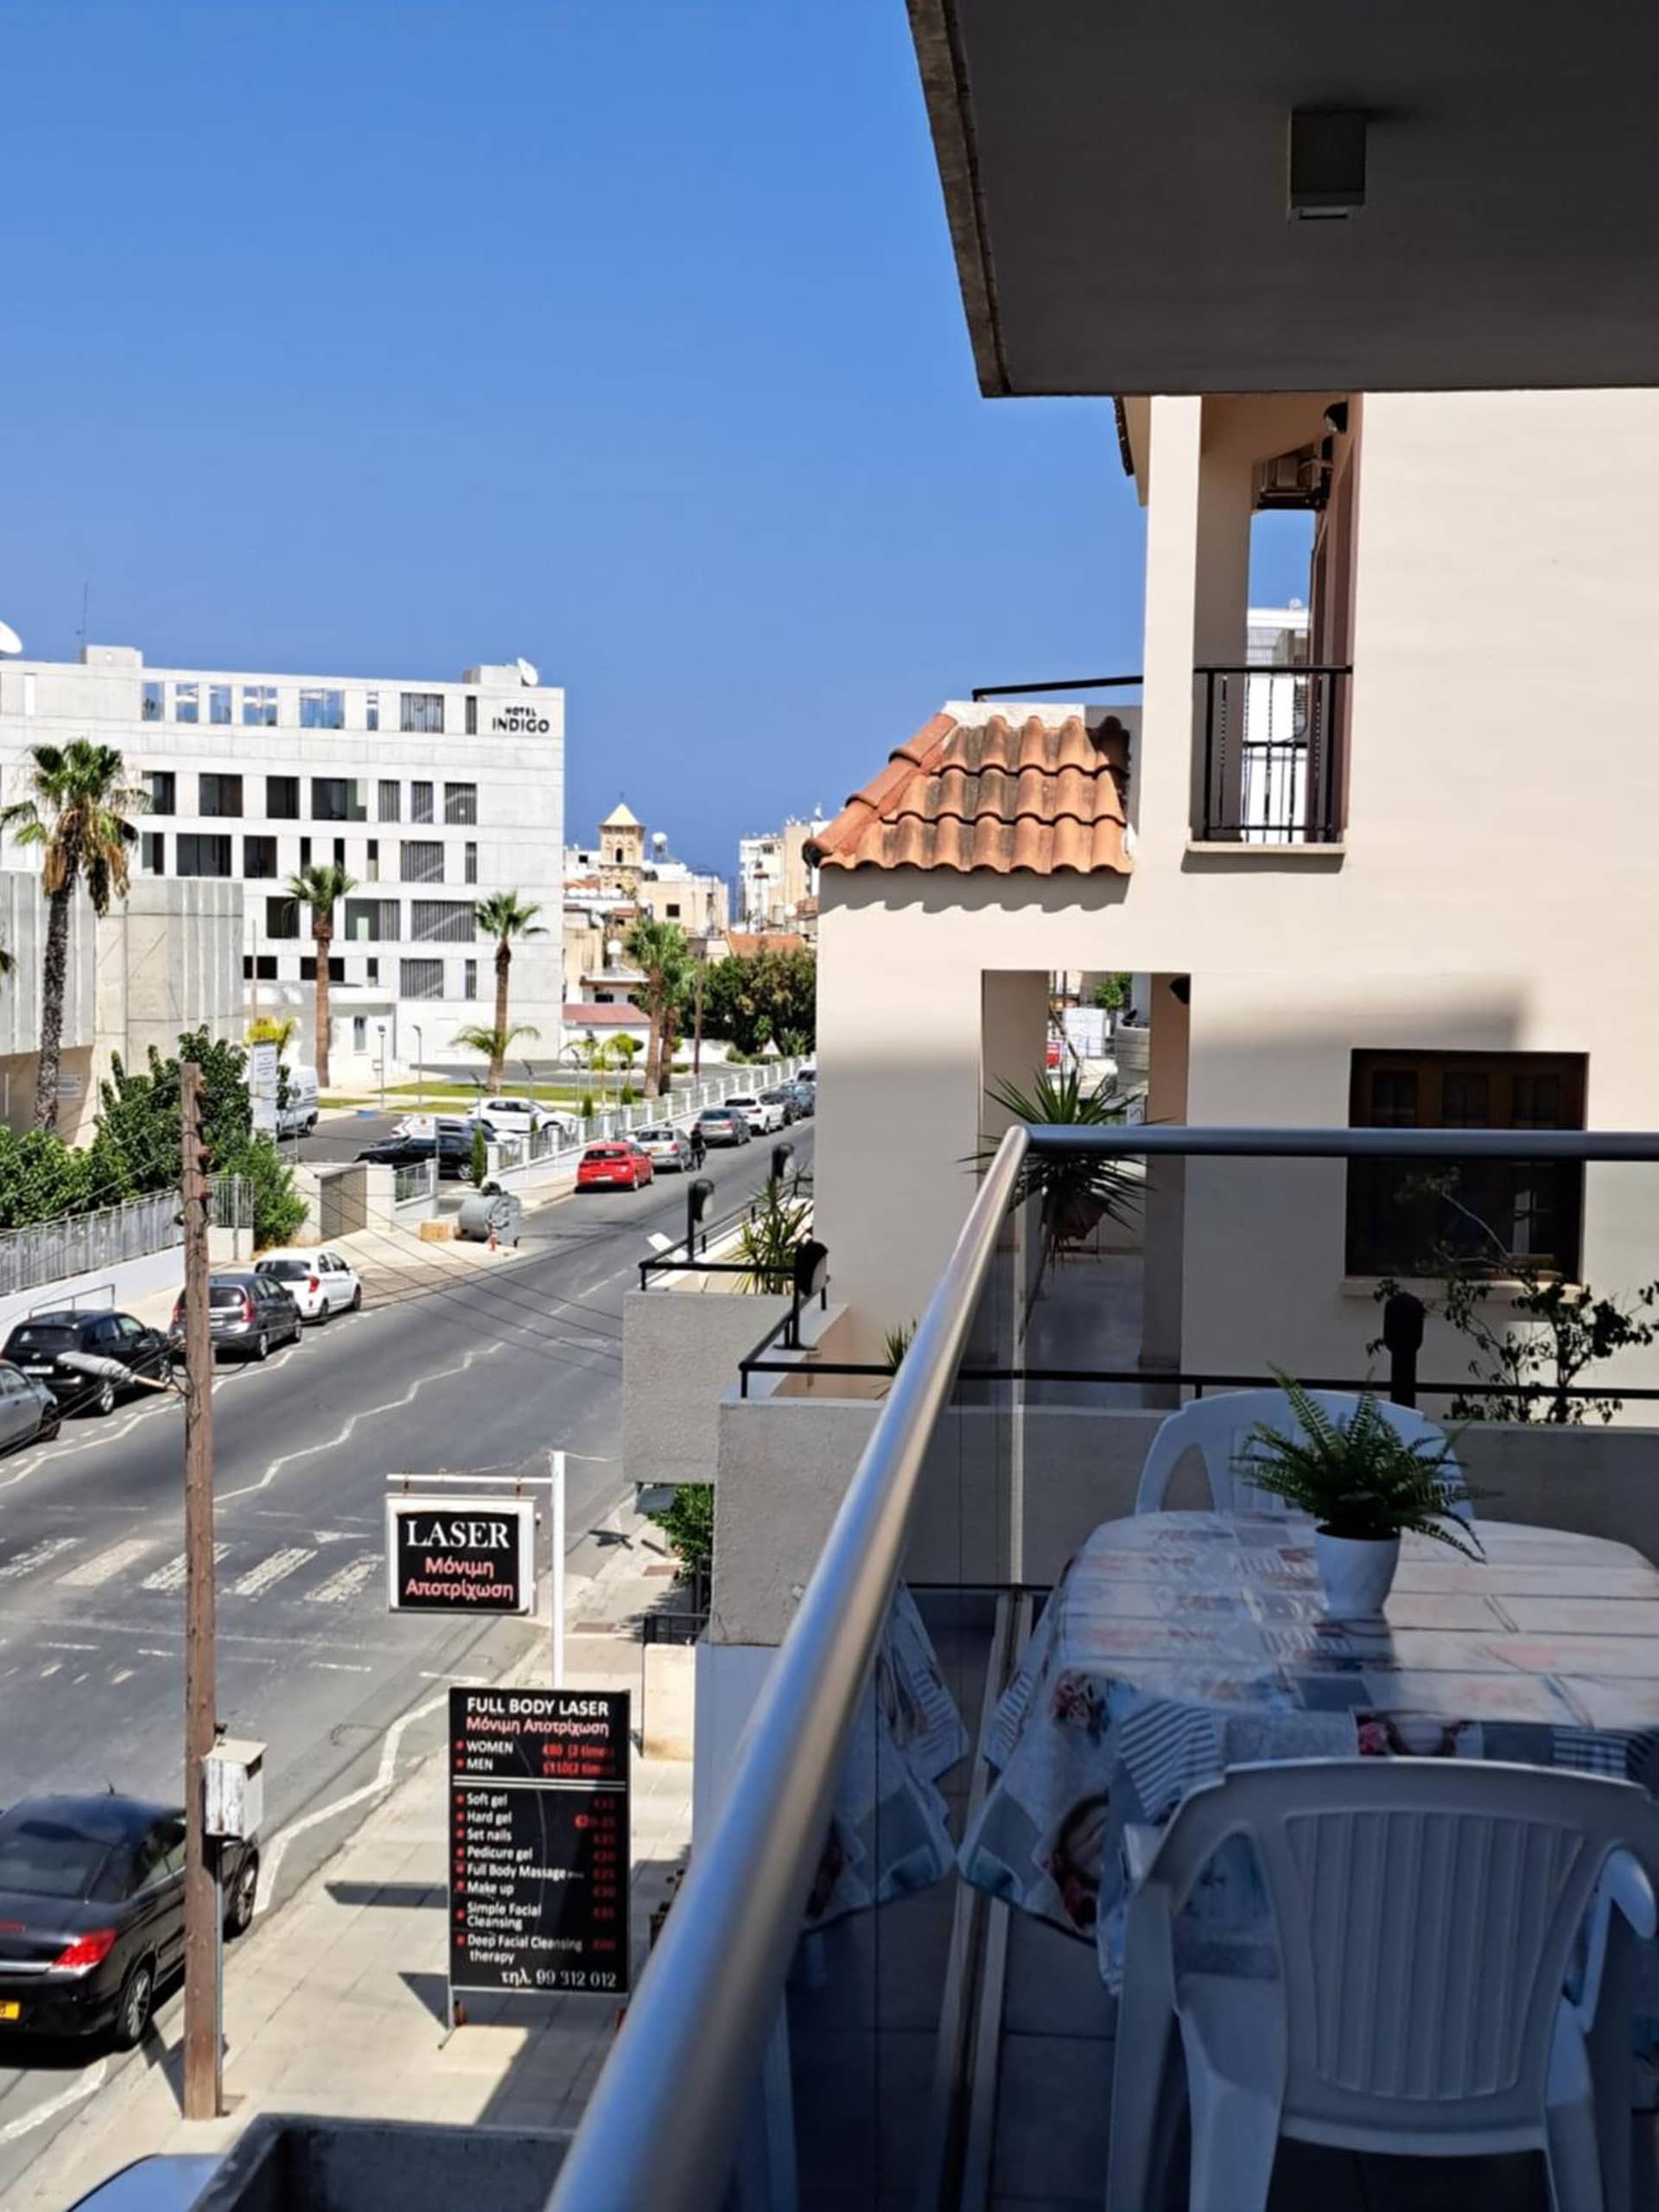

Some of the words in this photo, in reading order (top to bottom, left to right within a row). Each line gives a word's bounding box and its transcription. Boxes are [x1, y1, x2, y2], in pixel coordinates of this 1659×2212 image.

[505, 706, 537, 717] HOTEL
[492, 717, 550, 734] INDIGO
[406, 1520, 510, 1548] LASER
[424, 1555, 494, 1579] Μόνιμη
[405, 1579, 513, 1601] Αποτρίχωση
[467, 1697, 505, 1713] FULL
[510, 1699, 555, 1714] BODY
[559, 1700, 609, 1716] LASER
[466, 1716, 520, 1734] Μόνιμη
[523, 1719, 610, 1738] Αποτρίχωση
[467, 1739, 513, 1755] WOMEN
[467, 1758, 493, 1770] MEN
[467, 1793, 488, 1805] Soft
[491, 1794, 508, 1808] gel
[467, 1811, 493, 1823] Hard
[495, 1812, 512, 1826] gel
[467, 1829, 484, 1840] Set
[486, 1829, 512, 1842] nails
[467, 1847, 513, 1859] Pedicure
[516, 1847, 533, 1862] gel
[467, 1864, 486, 1876] Full
[489, 1865, 517, 1879] Body
[518, 1867, 566, 1882] Massage
[467, 1883, 497, 1894] Make
[499, 1885, 514, 1897] up
[467, 1903, 505, 1916] Simple
[508, 1903, 542, 1916] Facial
[467, 1916, 523, 1931] Cleansing
[467, 1935, 495, 1949] Deep
[498, 1935, 528, 1948] Facial
[531, 1936, 582, 1951] Cleansing
[469, 1950, 515, 1964] therapy
[536, 1970, 556, 1985] 99
[560, 1971, 587, 1986] 312
[589, 1972, 617, 1987] 012
